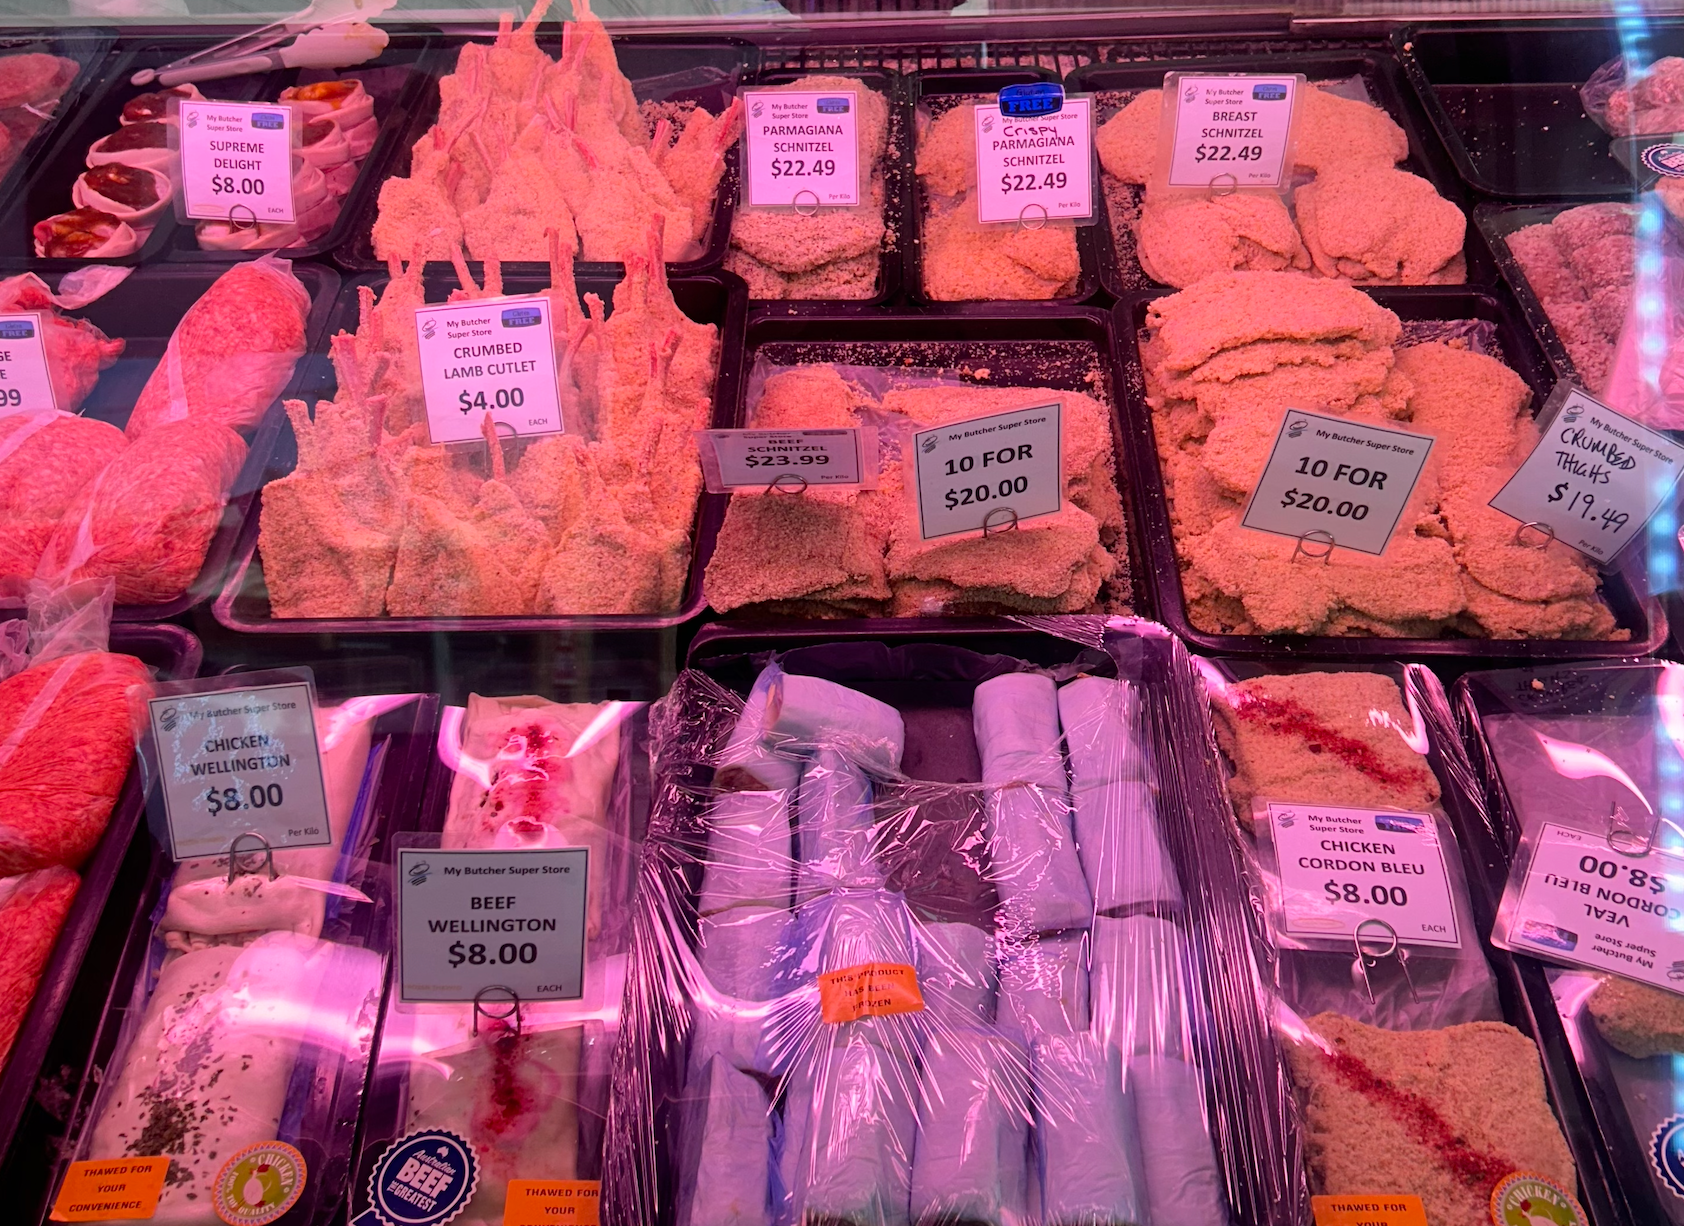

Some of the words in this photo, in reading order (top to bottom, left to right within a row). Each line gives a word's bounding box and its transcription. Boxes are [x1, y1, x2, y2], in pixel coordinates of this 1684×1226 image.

[1008, 98, 1053, 112] FREE
[206, 114, 217, 122] My
[1041, 114, 1059, 122] Super
[1212, 111, 1258, 122] BREAST
[206, 124, 224, 132] Super
[763, 125, 843, 136] PARMAGIANA
[1003, 126, 1058, 140] Crispy
[1201, 128, 1264, 138] SCHNITZEL
[210, 141, 264, 154] SUPREME
[774, 142, 834, 152] SCHNITZEL
[992, 136, 1075, 150] PARMAGIANA
[1194, 143, 1262, 163] $22.49
[214, 158, 262, 170] DELIGHT
[772, 158, 835, 179] $22.49
[1004, 154, 1065, 168] SCHNITZEL
[212, 174, 264, 194] $8.00
[1001, 172, 1068, 194] $22.49
[446, 320, 458, 328] My
[461, 318, 490, 326] Butcher
[509, 316, 534, 326] FREE
[2, 330, 28, 338] FREE
[454, 342, 522, 358] CRUMBED
[444, 366, 483, 380] LAMB
[487, 360, 536, 376] CUTLET
[459, 388, 524, 415] $4.00
[528, 418, 548, 426] EACH
[948, 434, 962, 442] My
[964, 426, 996, 438] Butcher
[998, 420, 1022, 430] Super
[1024, 416, 1046, 425] Store
[1316, 429, 1330, 439] My
[1332, 433, 1364, 446] Butcher
[1366, 440, 1390, 450] Super
[1392, 444, 1414, 456] Store
[1590, 416, 1603, 430] My
[1604, 423, 1632, 443] Butcher
[1632, 439, 1654, 454] Super
[1653, 450, 1674, 464] Store
[1560, 427, 1636, 470] CRUMBED
[745, 454, 830, 468] $23.99
[944, 456, 974, 476] 10
[983, 444, 1033, 468] FOR
[1556, 451, 1612, 484] THIGHS
[1295, 456, 1328, 477] 10
[1333, 464, 1388, 490] FOR
[945, 476, 1028, 510] $20.00
[1280, 488, 1369, 520] $20.00
[1578, 539, 1591, 550] Per
[1590, 544, 1604, 556] Kilo
[207, 706, 242, 718] Butcher
[244, 704, 270, 714] Super
[272, 702, 296, 710] Store
[205, 735, 269, 752] CHICKEN
[191, 754, 290, 776] WELLINGTON
[207, 783, 283, 817] $8.00
[1308, 815, 1323, 823] My
[1326, 816, 1362, 825] Butcher
[288, 828, 302, 836] Per
[304, 826, 319, 836] Kilo
[1310, 824, 1337, 834] Super
[1339, 826, 1364, 834] Store
[1556, 830, 1582, 841] EACH
[1320, 840, 1396, 854] CHICKEN
[444, 867, 462, 876] My
[464, 866, 506, 875] Butcher
[509, 866, 540, 876] Super
[542, 865, 570, 874] Store
[1298, 857, 1376, 872] CORDON
[1382, 862, 1424, 875] BLEU
[1579, 855, 1668, 894] $8.00
[1544, 873, 1591, 895] BLEU
[1324, 880, 1408, 906] $8.00
[471, 896, 516, 910] BEEF
[1596, 888, 1681, 920] CORDON
[1583, 904, 1630, 928] VEAL
[428, 918, 556, 933] WELLINGTON
[1422, 924, 1446, 933] EACH
[1594, 933, 1623, 948] Store
[448, 940, 538, 968] $8.00
[1592, 945, 1634, 963] Butcher
[1625, 943, 1657, 958] Super
[1636, 957, 1654, 969] My
[830, 976, 853, 984] THIS
[858, 970, 904, 980] PRODUCT
[537, 984, 562, 992] EACH
[845, 986, 864, 996] HAS
[868, 983, 895, 992] BEEN
[853, 999, 892, 1012] FROZEN
[258, 1154, 294, 1186] CHICKEN
[412, 1150, 456, 1175] Australian
[84, 1166, 127, 1177] THAWED
[130, 1165, 152, 1174] FOR
[396, 1157, 454, 1198] BEEF
[97, 1184, 126, 1194] YOUR
[386, 1180, 400, 1192] THE
[394, 1184, 438, 1212] GREATEST
[526, 1188, 572, 1196] THAWED
[577, 1189, 598, 1197] FOR
[1508, 1184, 1560, 1206] CHICKEN
[69, 1201, 142, 1212] CONVENIENCE
[226, 1194, 238, 1208] TOP
[238, 1202, 275, 1216] QUALITY
[544, 1206, 575, 1214] YOUR
[1331, 1204, 1380, 1212] THAWED
[1384, 1204, 1406, 1212] FOR
